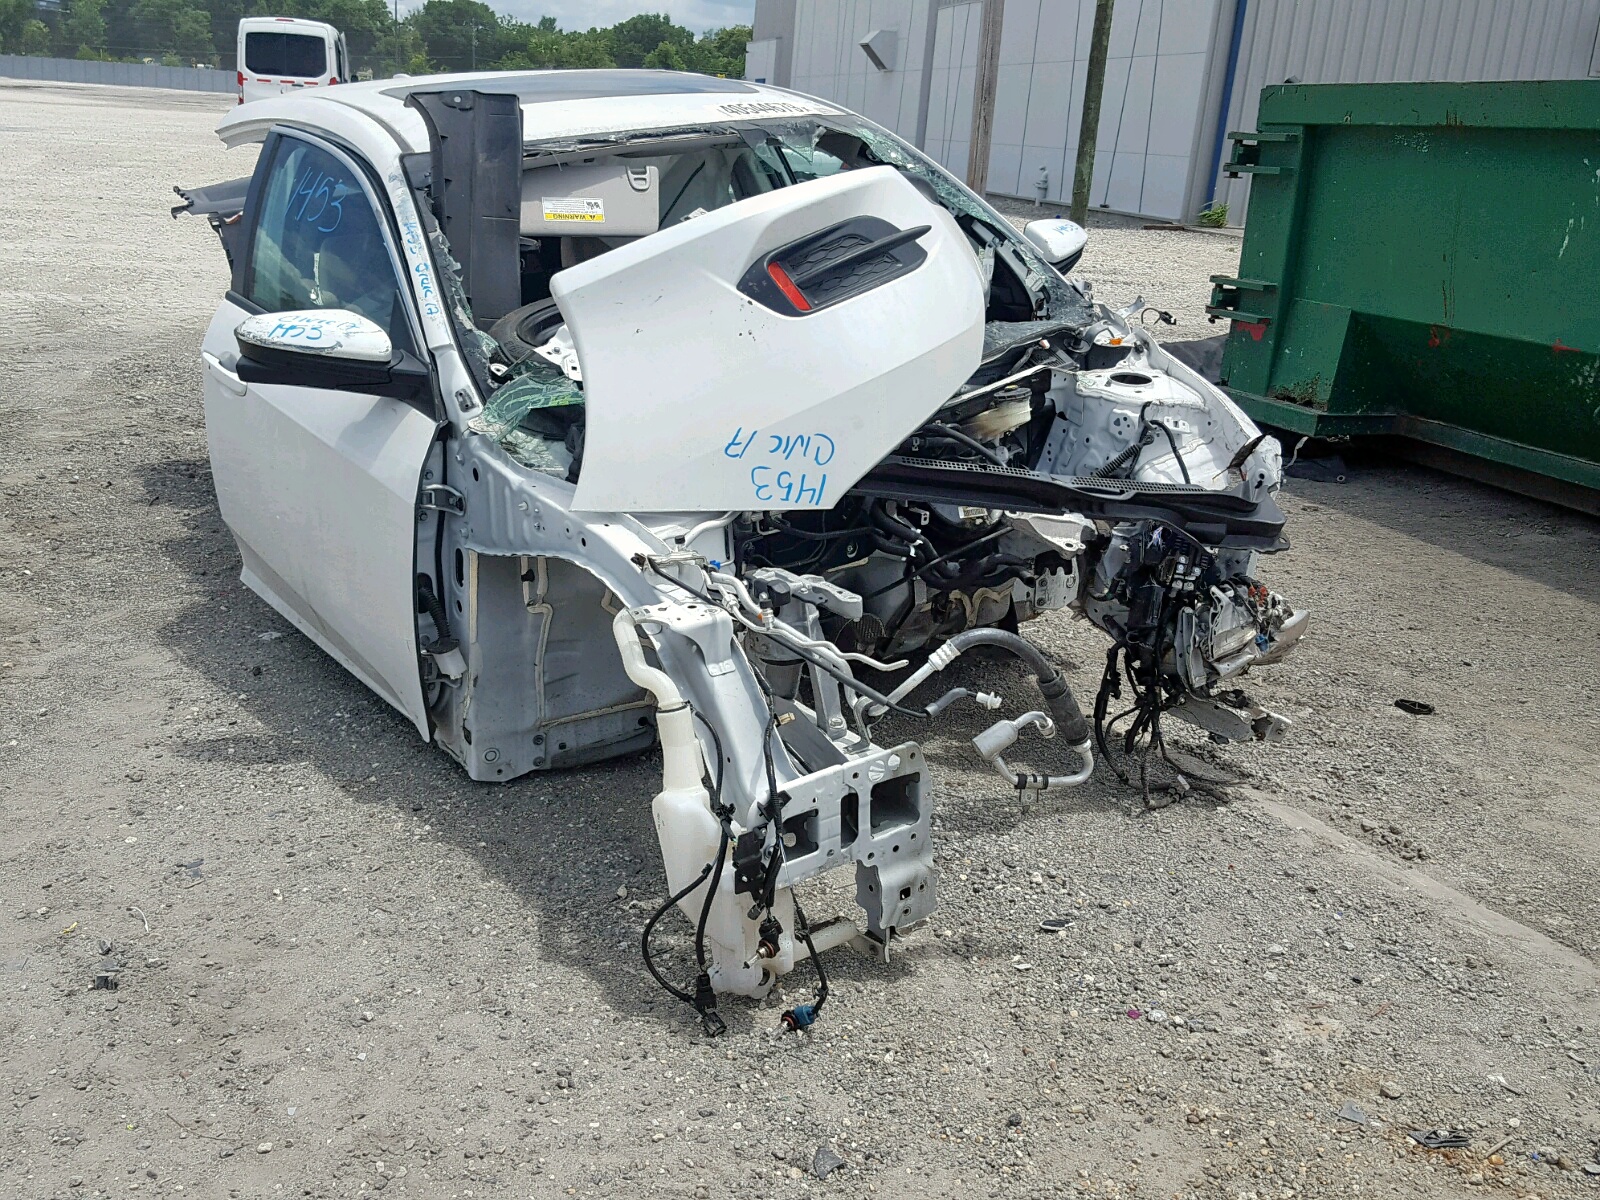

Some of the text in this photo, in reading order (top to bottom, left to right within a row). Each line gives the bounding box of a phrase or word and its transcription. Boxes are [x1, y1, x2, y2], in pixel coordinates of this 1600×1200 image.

[283, 166, 347, 232] 1453
[267, 323, 323, 341] 1453
[724, 426, 758, 459] 17
[751, 465, 827, 506] 1453
